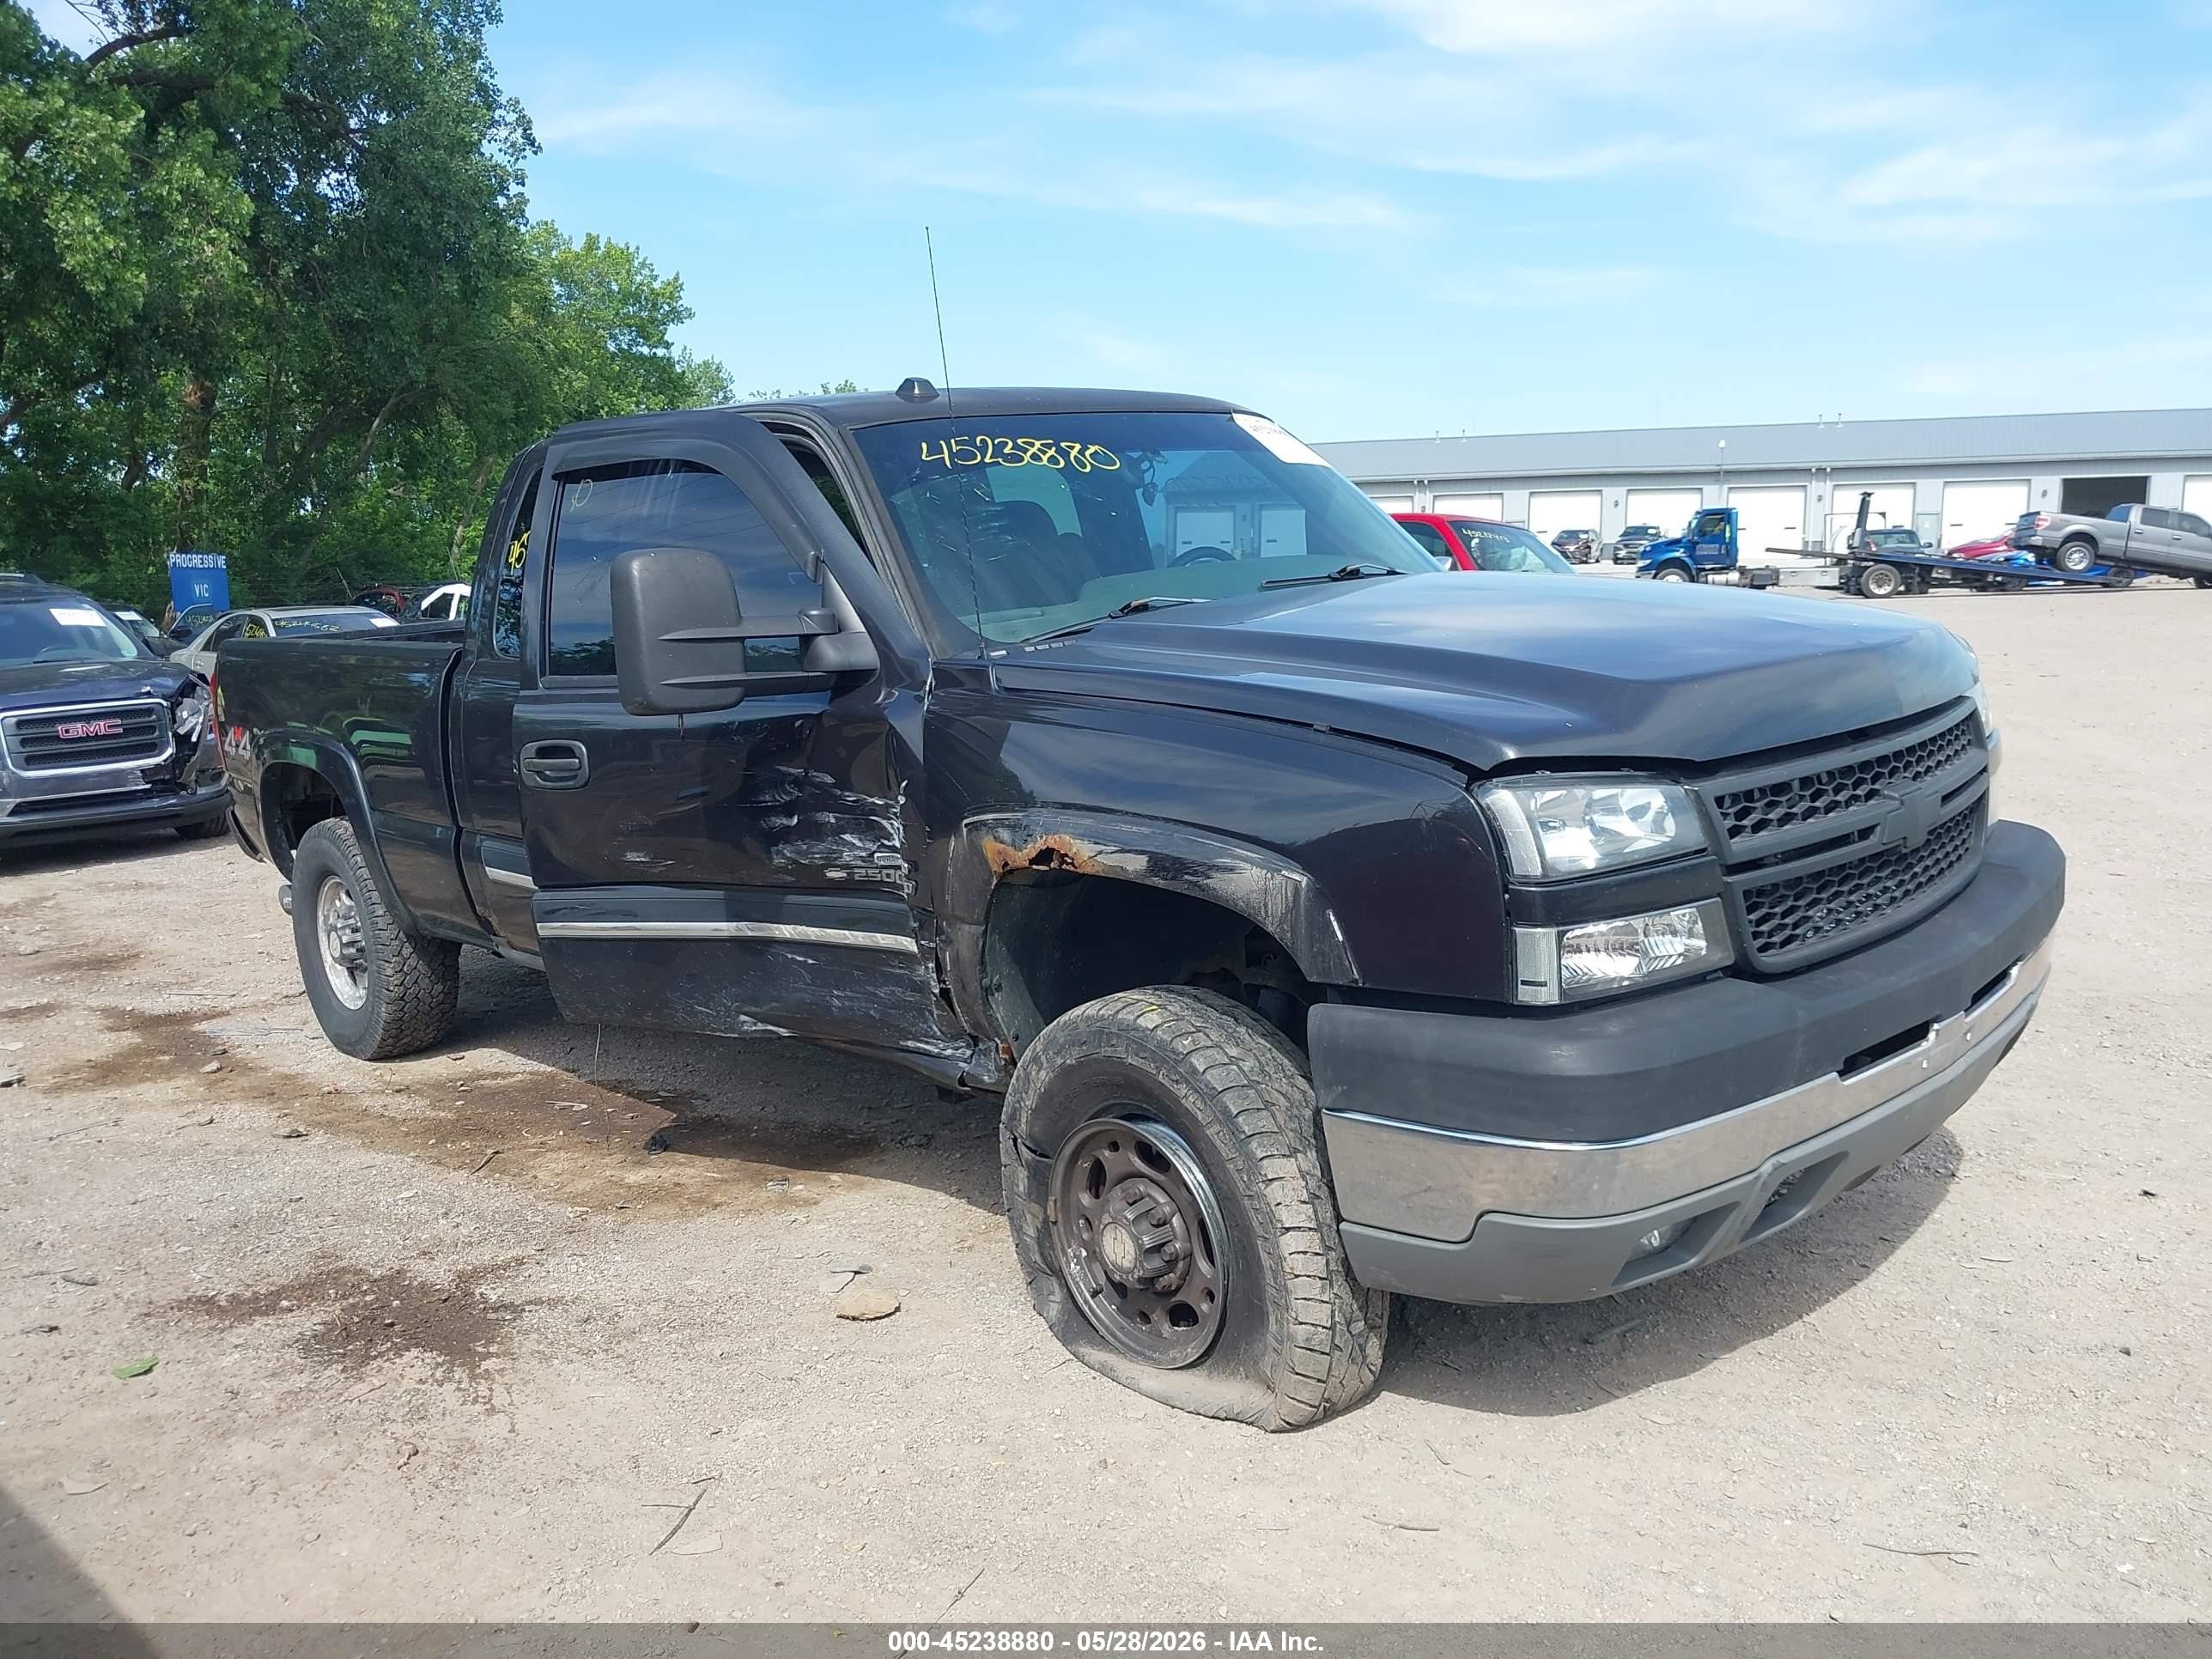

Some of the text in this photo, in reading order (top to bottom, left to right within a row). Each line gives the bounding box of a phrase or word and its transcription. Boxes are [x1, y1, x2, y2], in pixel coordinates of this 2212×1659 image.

[921, 435, 1120, 472] 45238880
[169, 554, 227, 568] PROGRESSIVE
[194, 583, 209, 597] VIC
[58, 720, 123, 738] GMC
